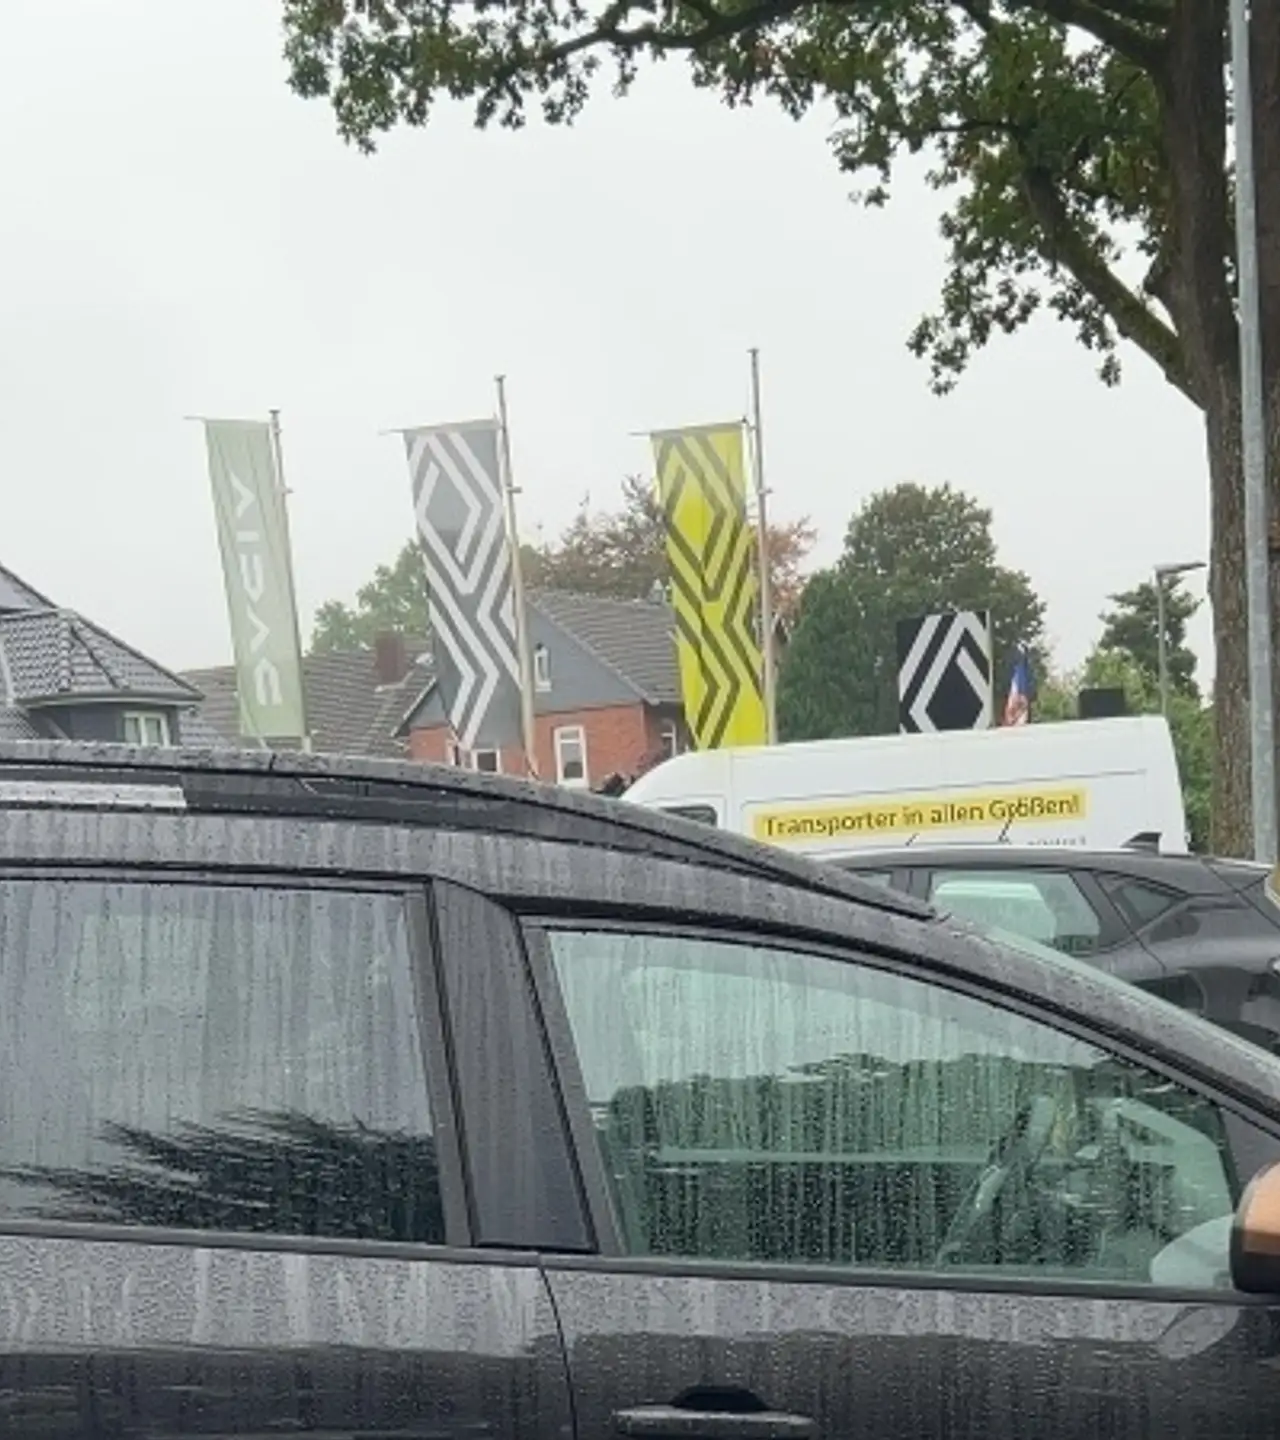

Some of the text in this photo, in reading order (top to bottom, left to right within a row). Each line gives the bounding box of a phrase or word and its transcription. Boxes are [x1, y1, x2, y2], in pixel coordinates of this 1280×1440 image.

[766, 795, 1080, 837] Transporter in allen Größen!
